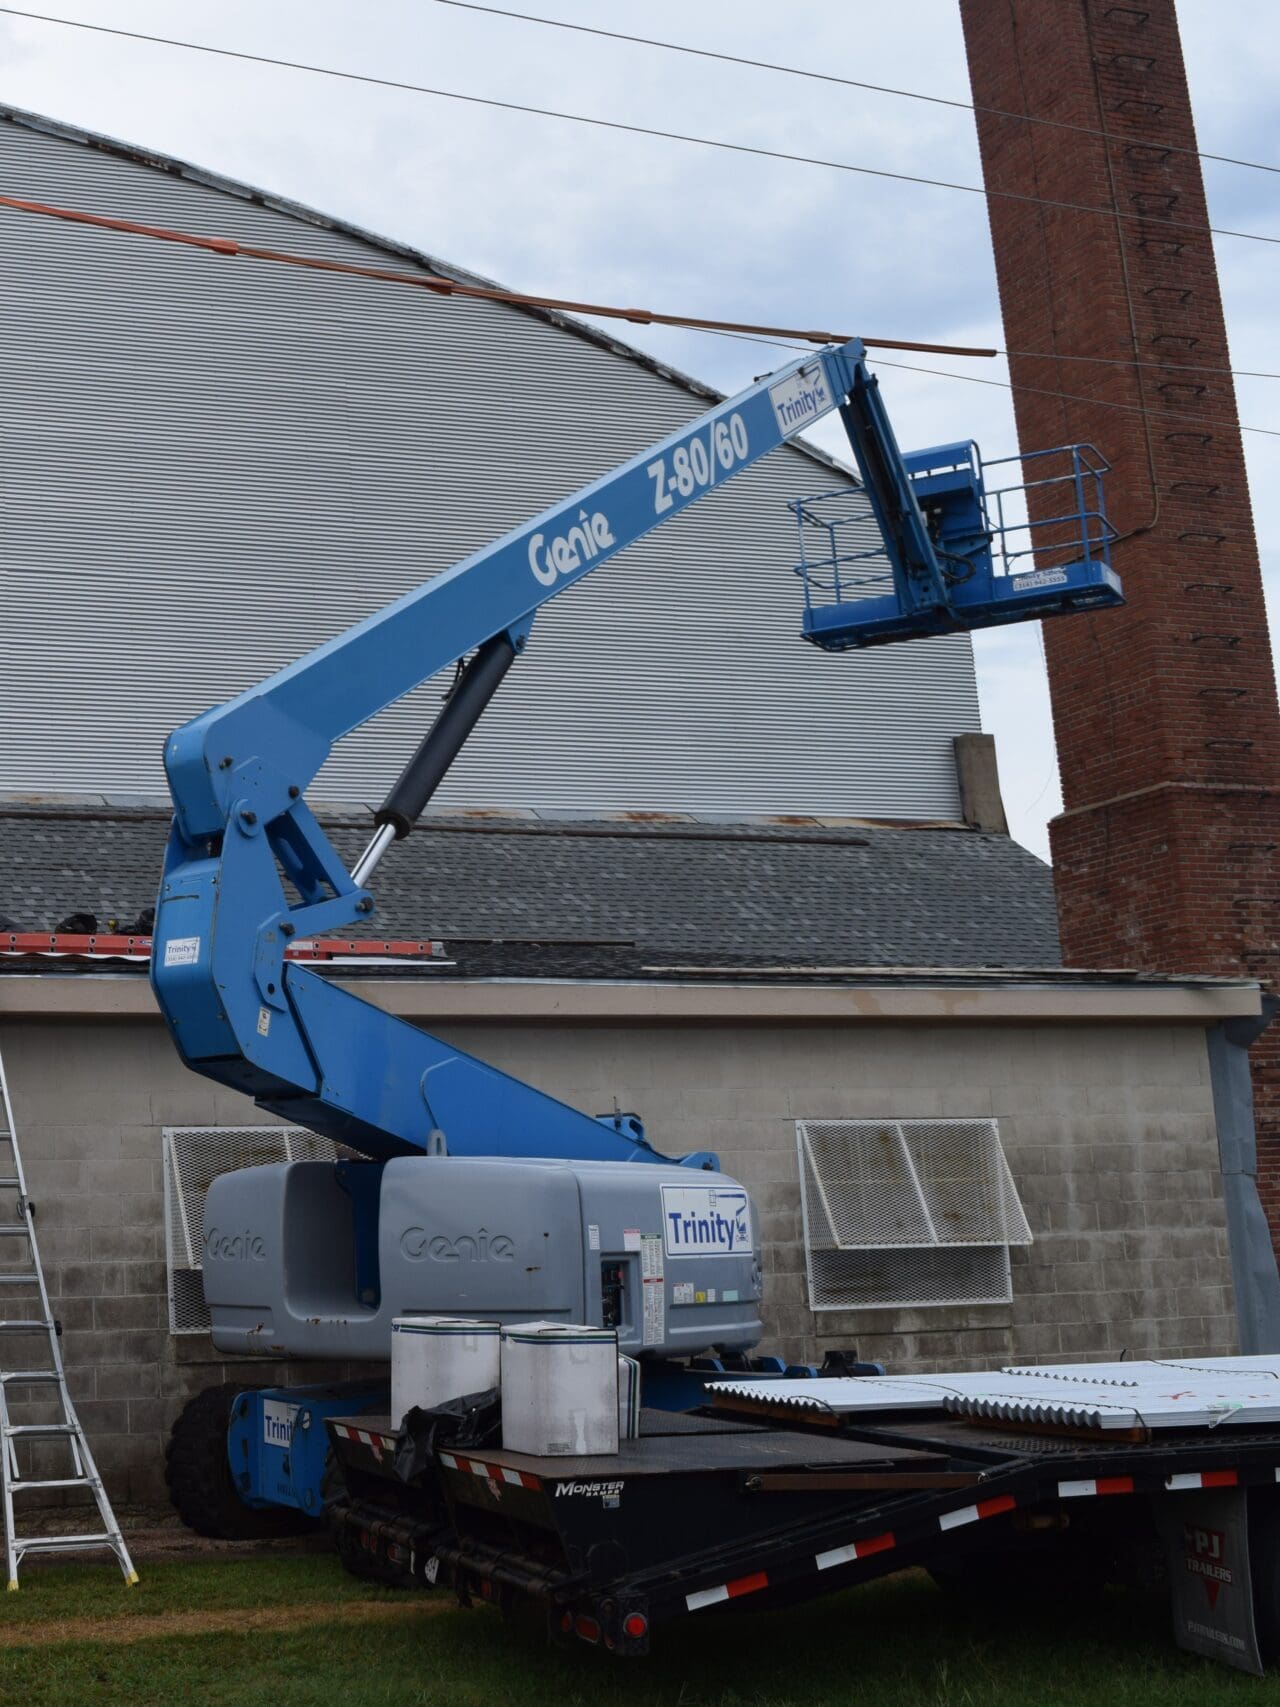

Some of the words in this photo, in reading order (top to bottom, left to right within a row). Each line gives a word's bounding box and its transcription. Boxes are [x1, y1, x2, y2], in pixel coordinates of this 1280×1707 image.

[777, 389, 817, 426] Trinity
[647, 412, 749, 515] Z-80/60
[528, 509, 616, 587] Genie
[167, 944, 191, 955] Trinity
[207, 1227, 267, 1263] Genie
[400, 1226, 515, 1263] Genie
[668, 1211, 735, 1251] Trinity
[265, 1414, 293, 1441] Trini
[1194, 1530, 1221, 1559] PJ
[1186, 1557, 1232, 1583] TRAILERS
